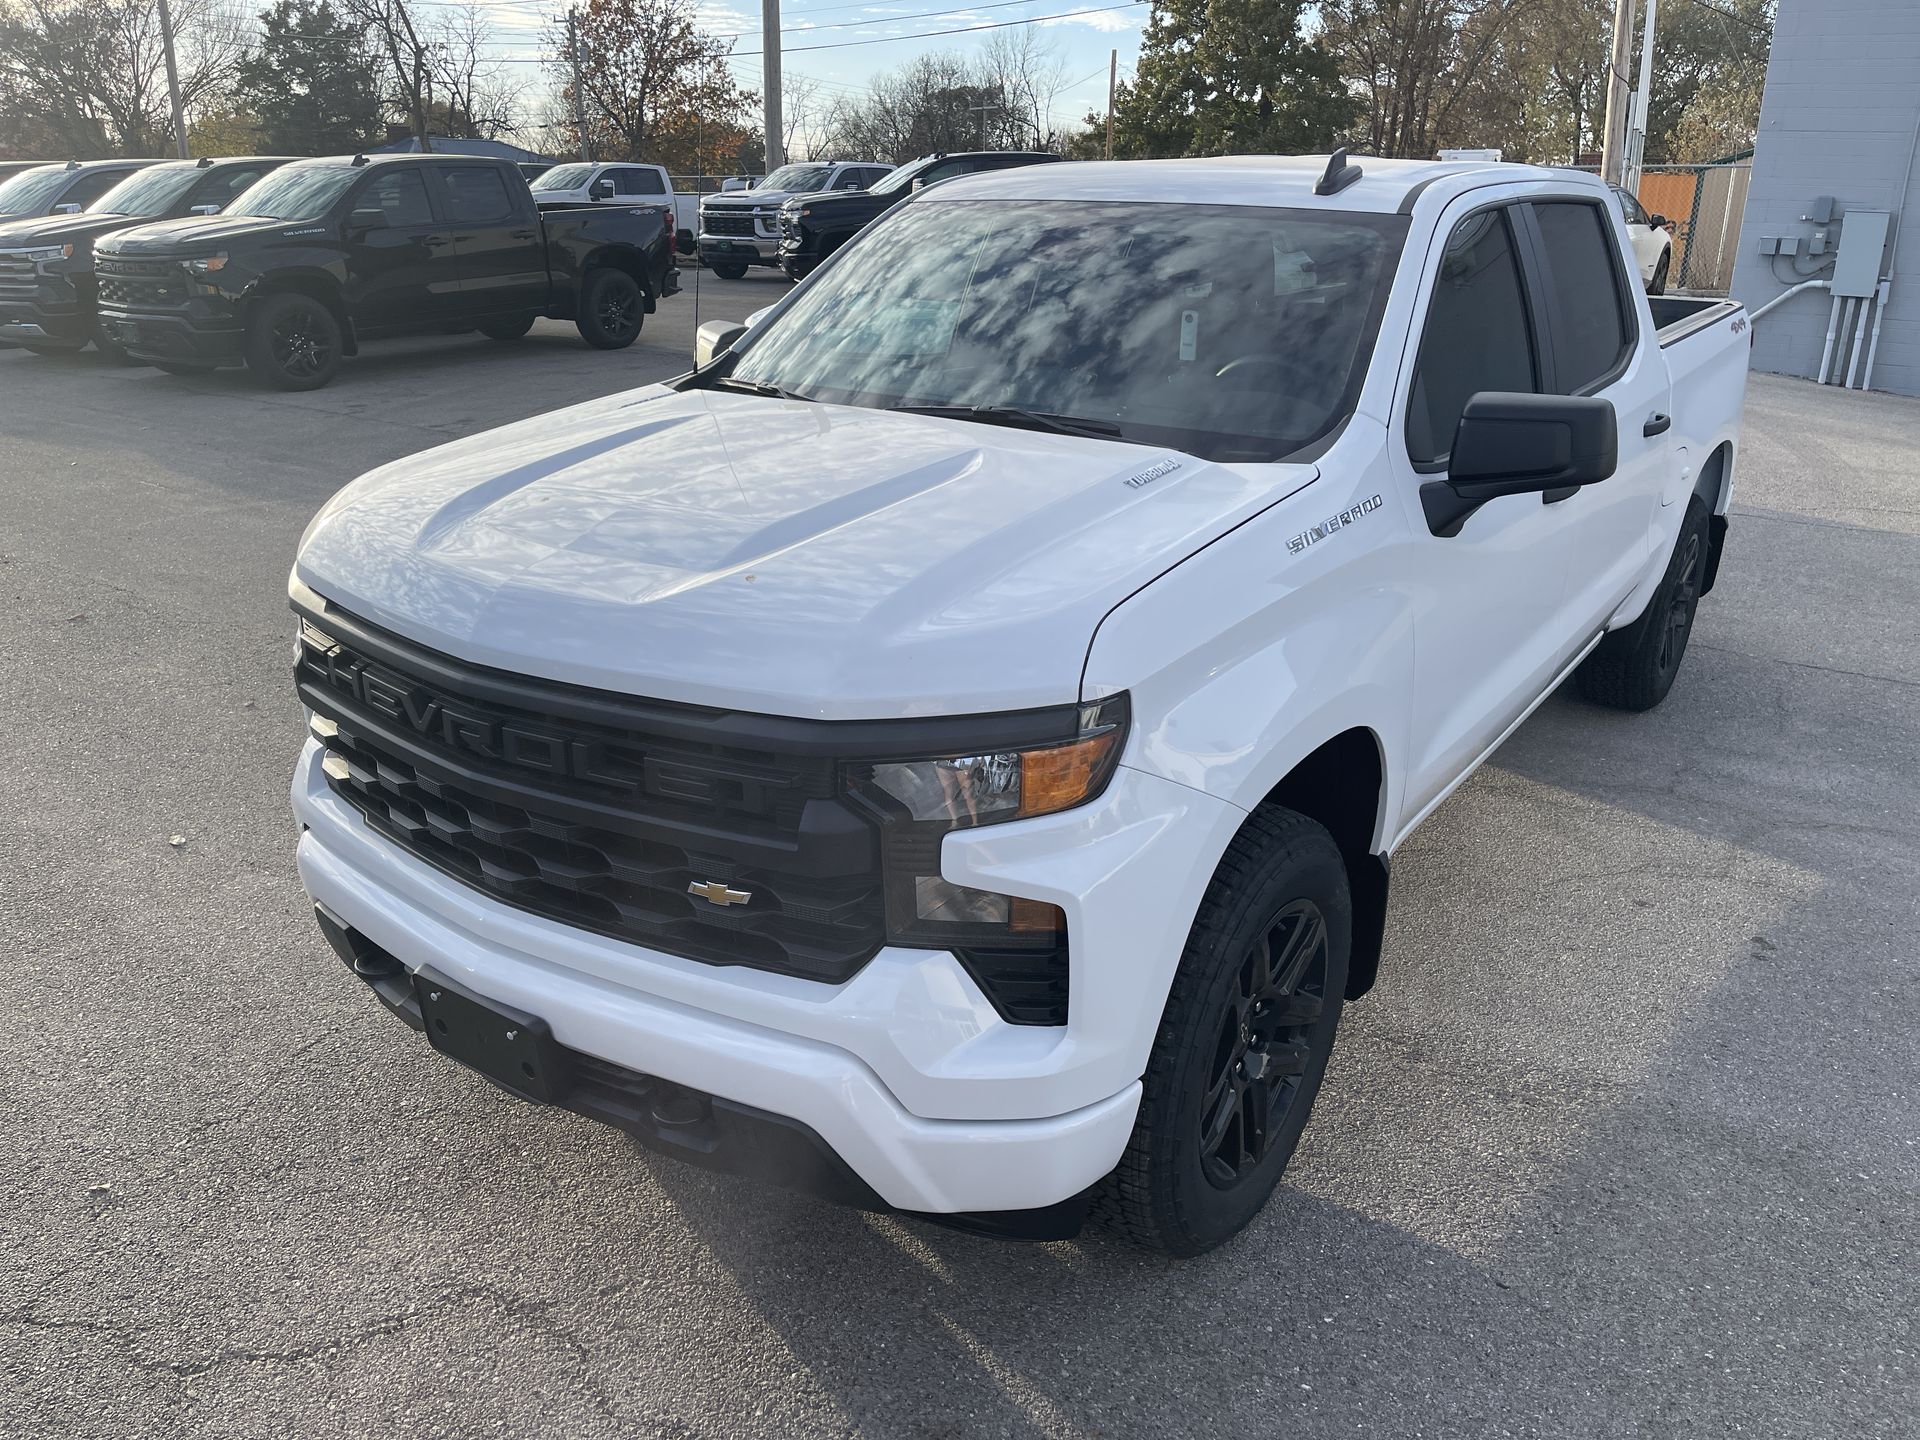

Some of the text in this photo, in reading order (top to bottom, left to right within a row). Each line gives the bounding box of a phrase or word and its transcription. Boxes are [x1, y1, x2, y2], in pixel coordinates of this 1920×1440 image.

[1123, 457, 1182, 489] TURBOMAX
[1286, 494, 1382, 555] SILVERADO
[300, 633, 796, 814] CHEVROLET
